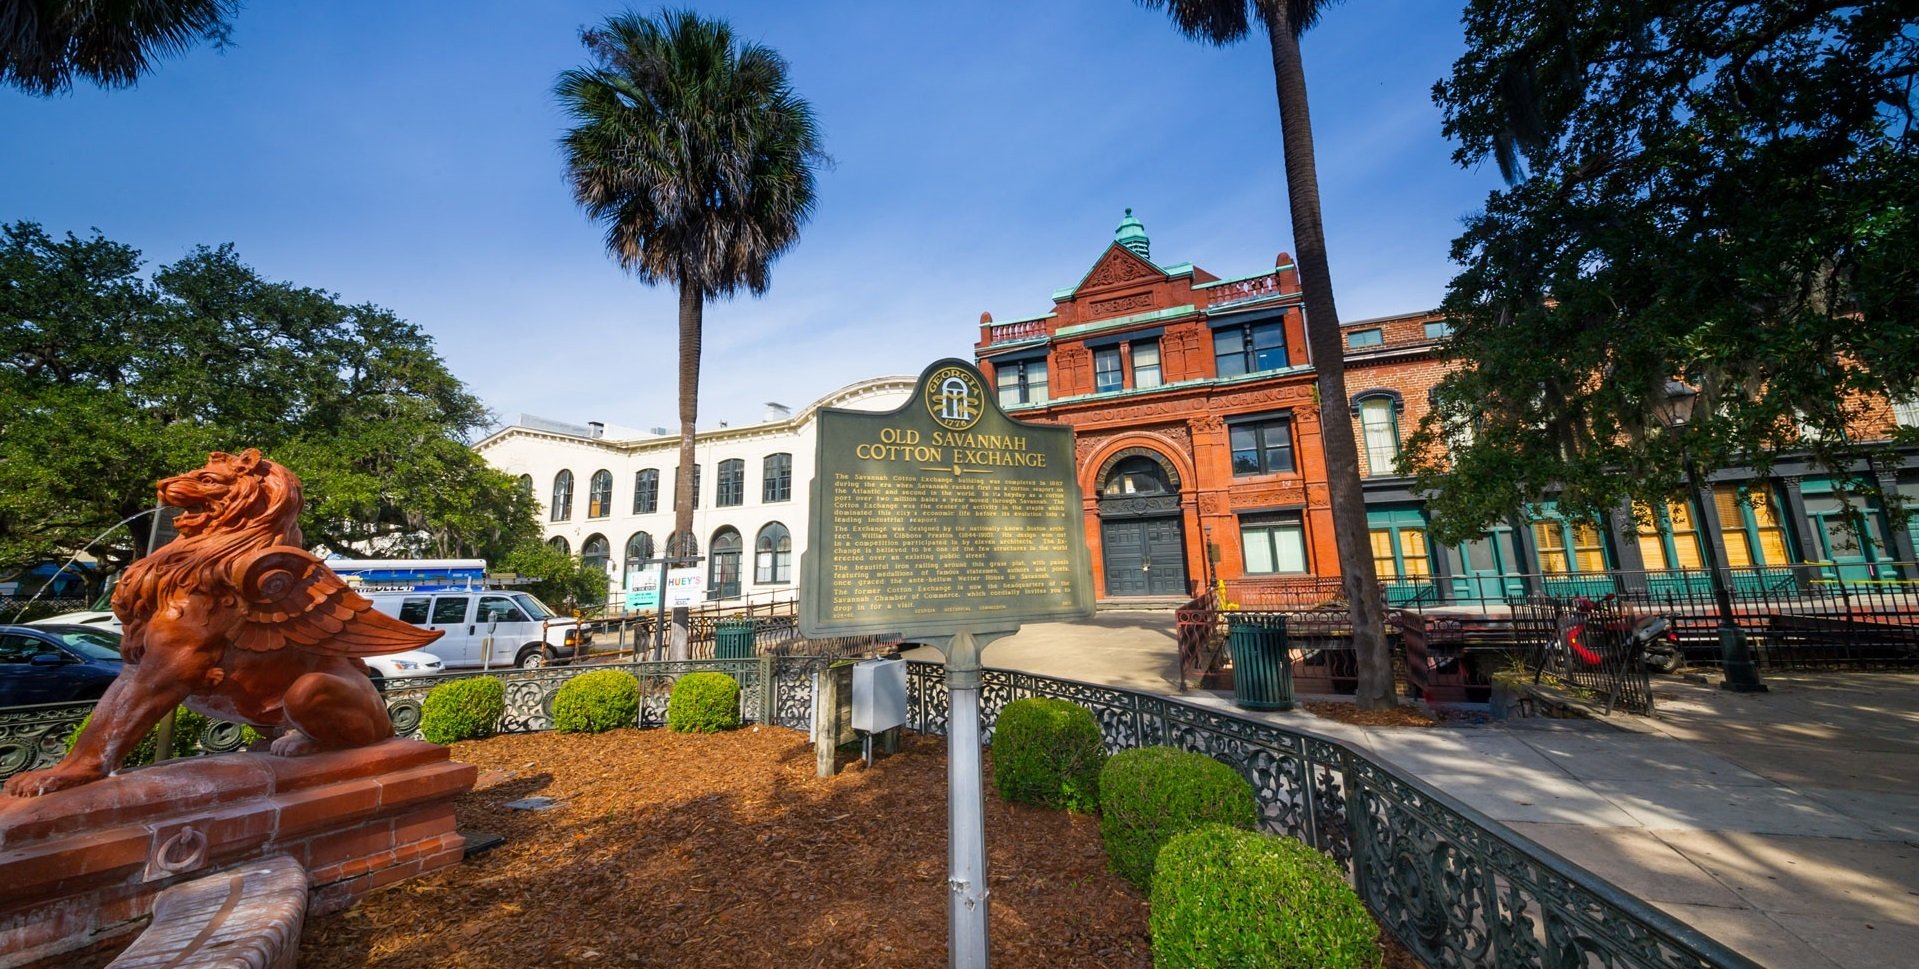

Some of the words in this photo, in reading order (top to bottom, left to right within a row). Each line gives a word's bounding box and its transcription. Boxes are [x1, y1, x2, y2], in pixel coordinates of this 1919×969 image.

[929, 370, 979, 396] GEORGIA
[1091, 404, 1170, 422] COTTON
[1209, 387, 1295, 410] EXCHANGE
[944, 418, 967, 427] 1776
[880, 428, 920, 445] OLD
[932, 431, 1026, 450] SAVANNAH
[856, 443, 941, 462] COTTON
[954, 450, 1046, 467] EXCHANGE
[668, 576, 701, 586] HUEY'S
